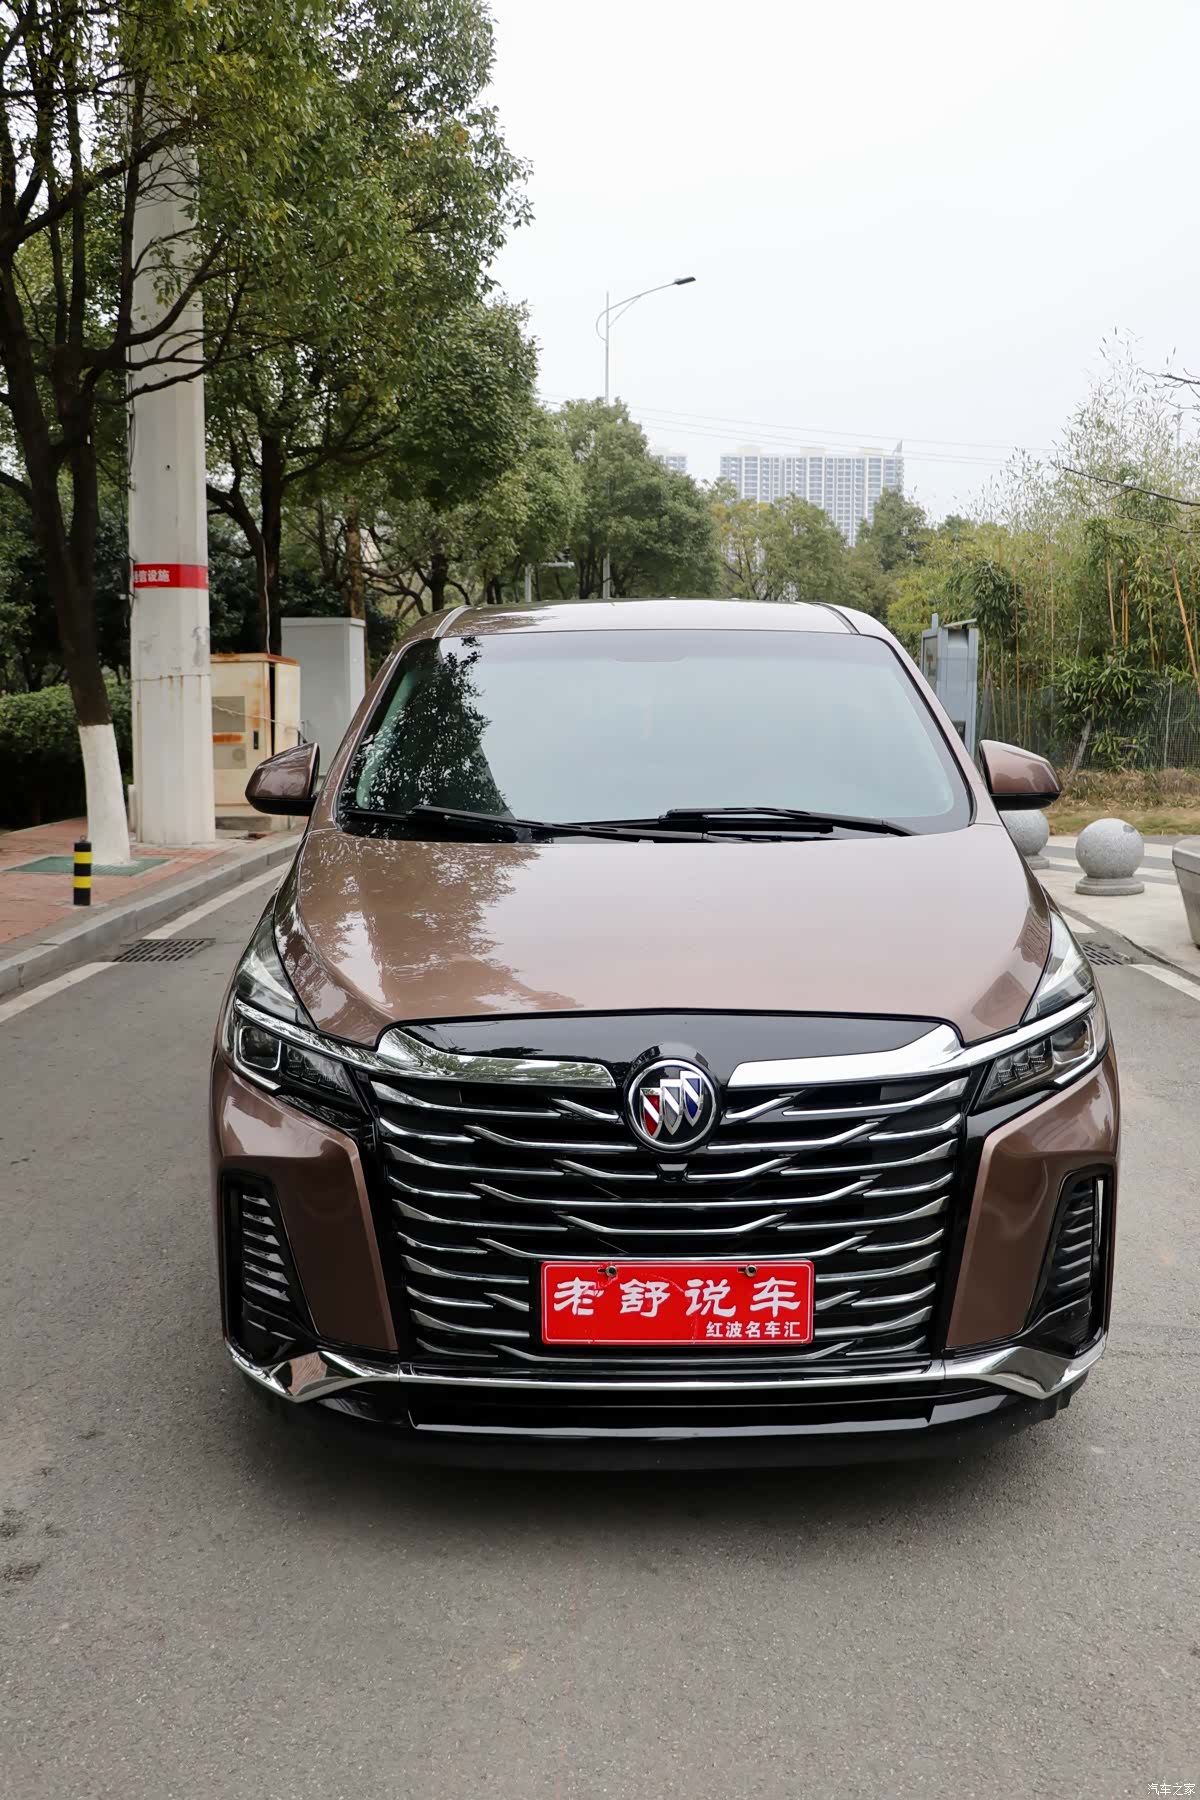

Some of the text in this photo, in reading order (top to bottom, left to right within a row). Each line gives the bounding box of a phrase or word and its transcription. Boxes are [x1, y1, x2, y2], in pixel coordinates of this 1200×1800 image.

[553, 1276, 801, 1318] 老舒说车
[706, 1321, 801, 1338] 红波名车汇
